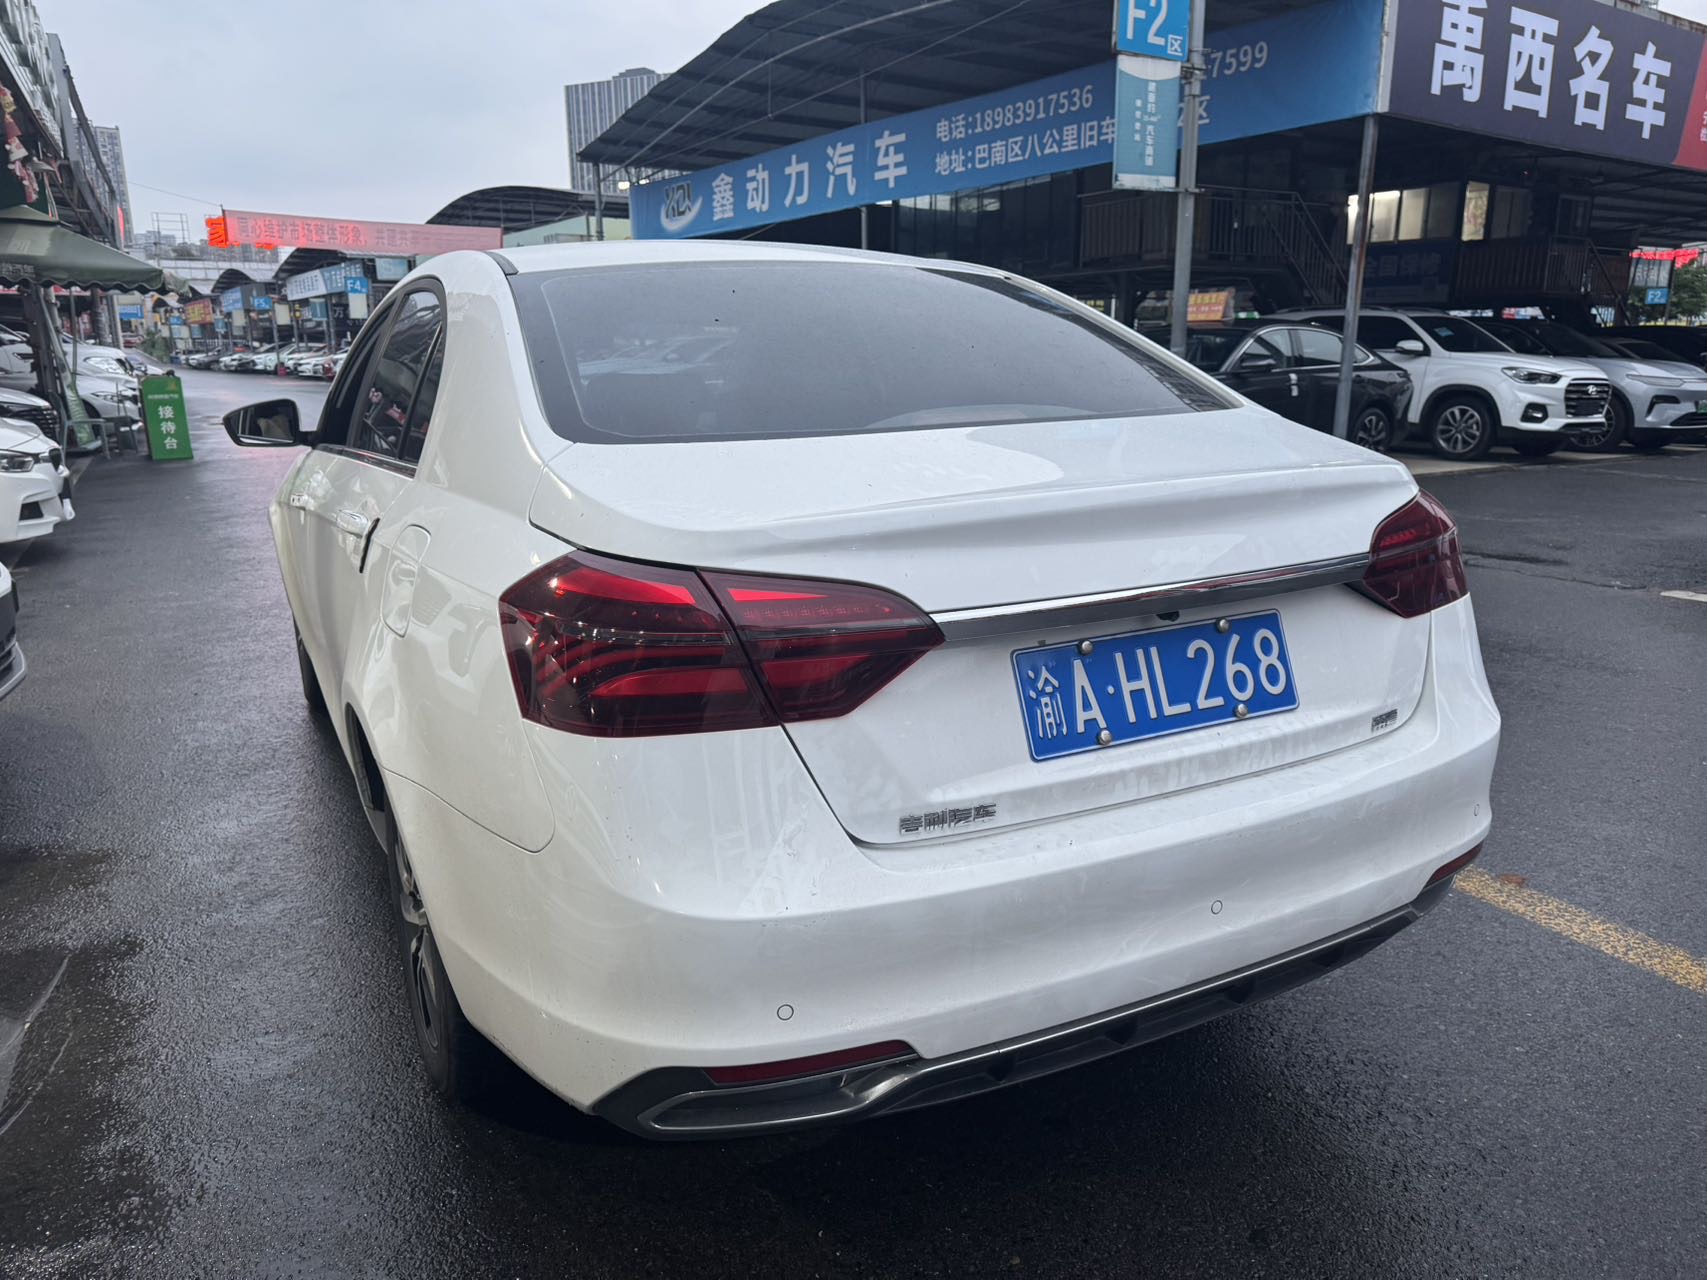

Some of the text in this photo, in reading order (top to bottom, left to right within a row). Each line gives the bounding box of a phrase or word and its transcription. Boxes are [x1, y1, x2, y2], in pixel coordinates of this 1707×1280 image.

[1430, 0, 1672, 140] 禹西名车
[711, 130, 909, 222] 鑫动力汽车
[157, 405, 178, 450] 接待台
[1027, 628, 1287, 740] 渝A·HL268
